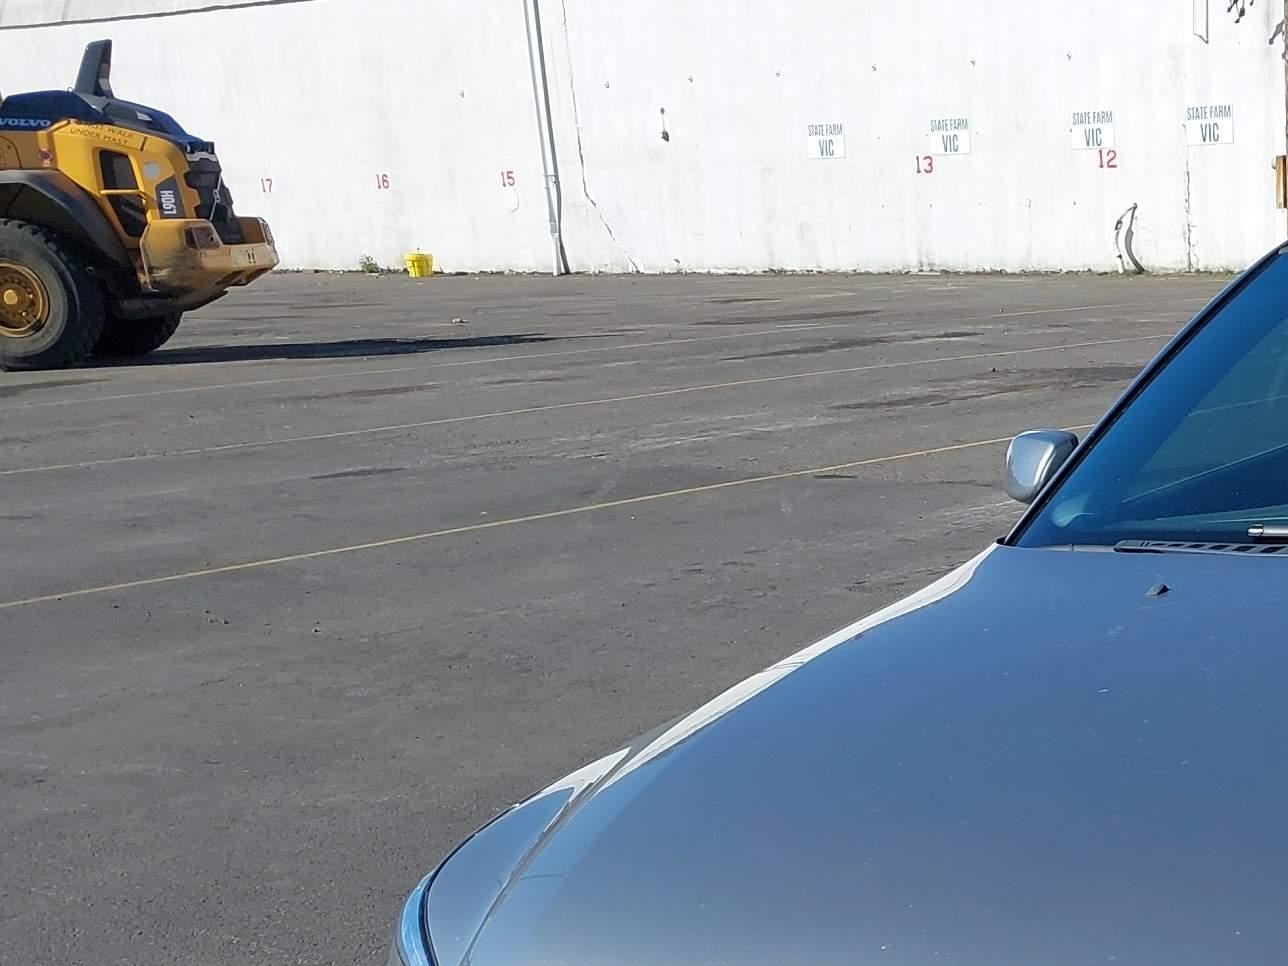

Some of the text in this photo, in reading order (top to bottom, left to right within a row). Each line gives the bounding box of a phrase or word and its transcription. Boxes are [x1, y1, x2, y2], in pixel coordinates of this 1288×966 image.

[1072, 110, 1113, 125] STATE FARM
[1187, 104, 1232, 120] STATE FARM
[0, 118, 51, 127] VOLVO
[808, 123, 843, 136] STATE FARM
[930, 117, 968, 132] STATE FARM
[1084, 127, 1102, 147] VIC
[1200, 122, 1220, 143] VIC
[818, 139, 835, 157] VIC
[942, 134, 959, 153] VIC
[916, 155, 933, 173] 13
[1099, 150, 1118, 168] 12
[261, 178, 273, 193] 17
[376, 174, 390, 190] 16
[501, 171, 515, 187] 15
[160, 190, 177, 215] L90H
